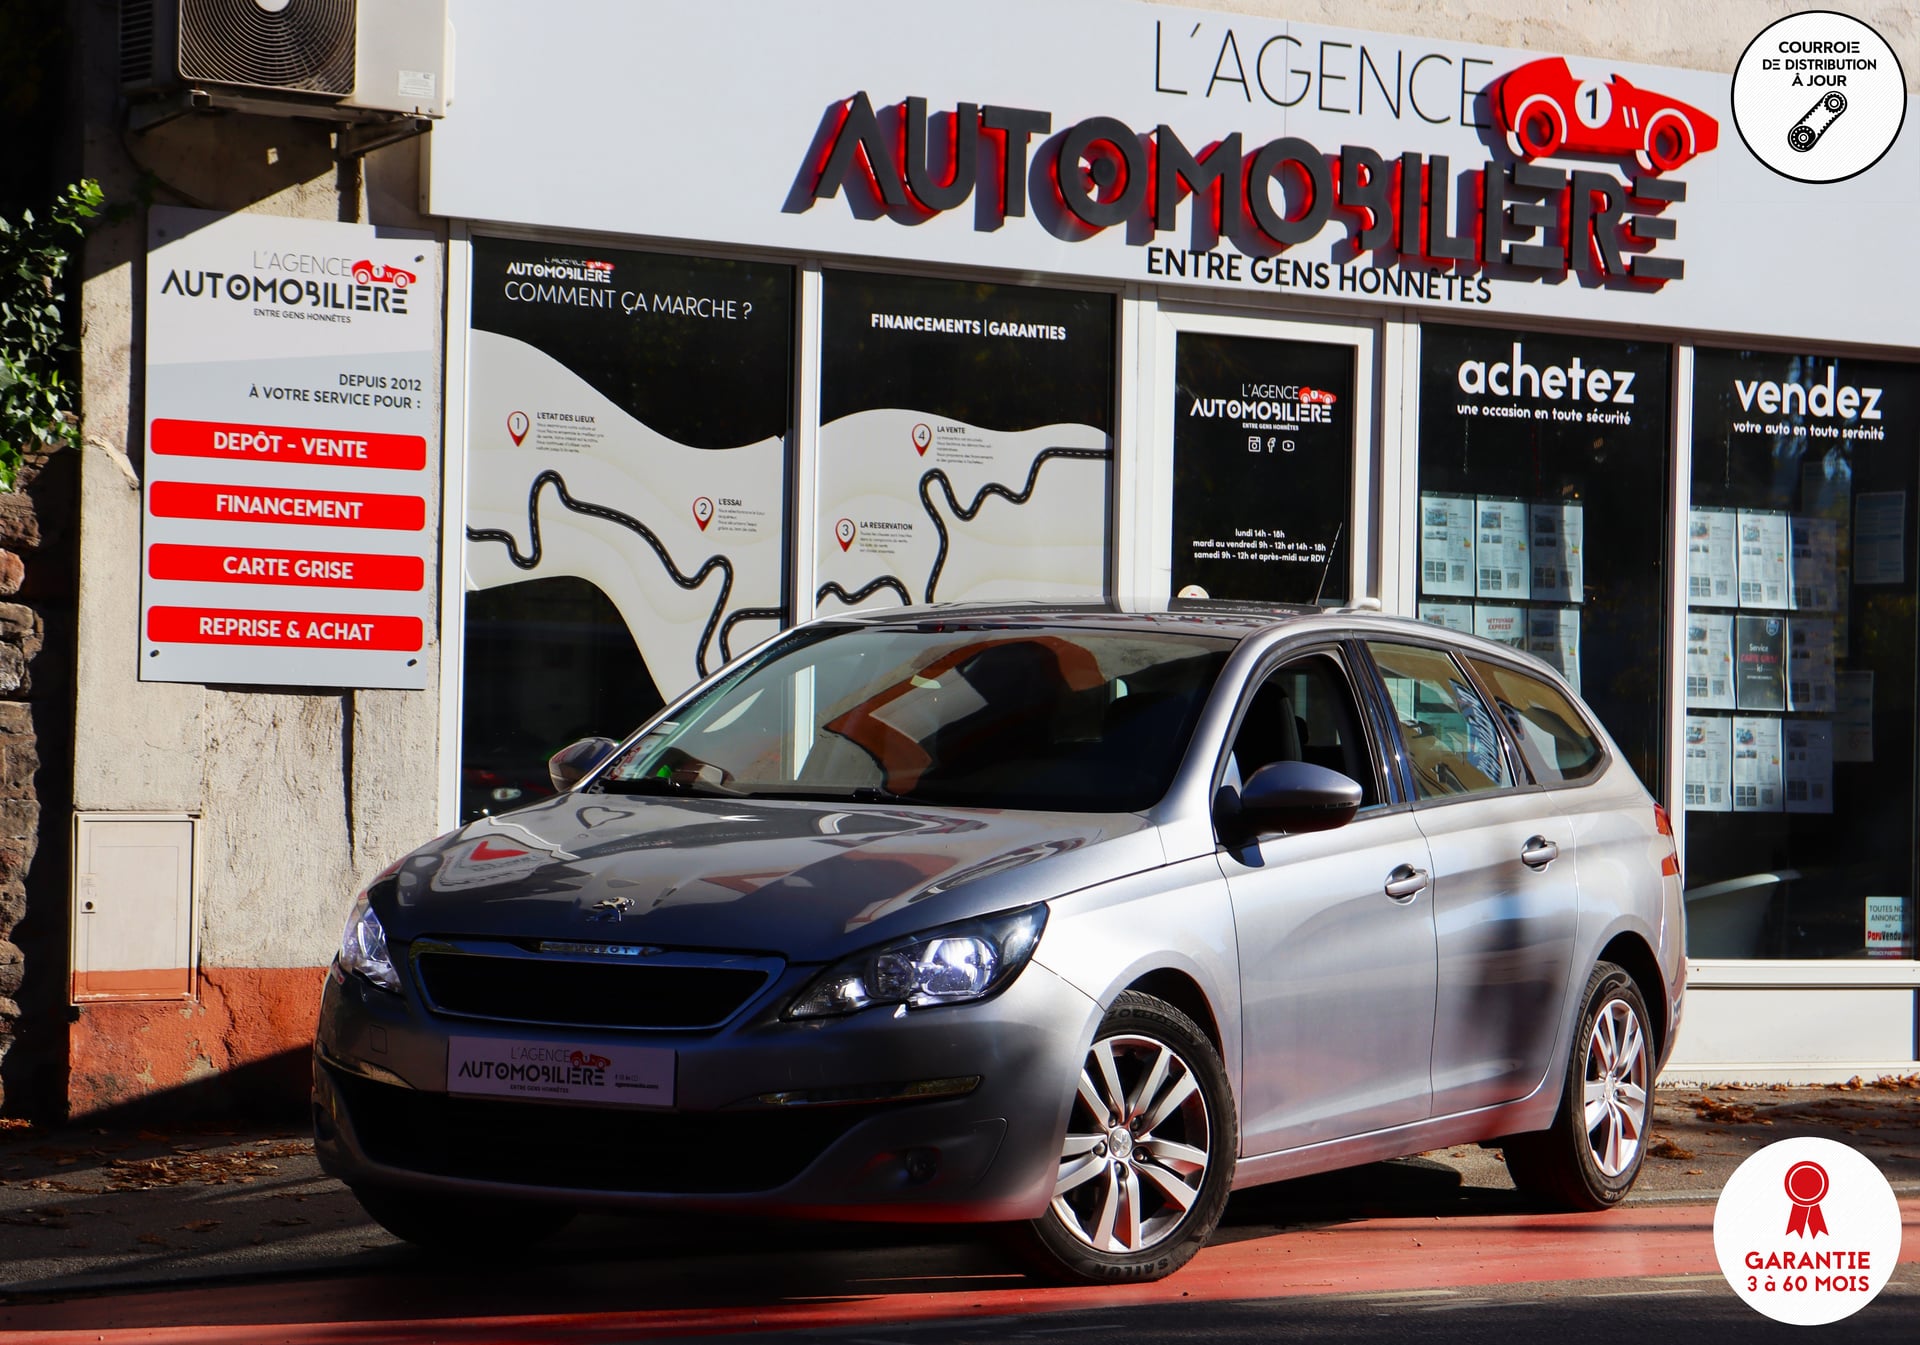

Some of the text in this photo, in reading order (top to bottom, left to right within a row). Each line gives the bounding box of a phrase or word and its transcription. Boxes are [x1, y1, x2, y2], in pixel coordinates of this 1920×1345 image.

[1155, 20, 1493, 129] L'AGENCE
[253, 250, 351, 277] L'AGENCE
[1148, 247, 1491, 303] ENTRE GENS HONNÊTES
[504, 281, 753, 320] COMMENT ÇA MARCHE ?
[254, 308, 351, 323] ENTRE GENS HONNÊTES
[871, 313, 1067, 341] FINANCEMENTS GARANTIES
[1457, 342, 1636, 404] achetez
[339, 374, 422, 391] DEPUIS 2012
[249, 384, 259, 397] À
[263, 387, 310, 402] VOTRE
[314, 390, 370, 406] SERVICE
[374, 394, 412, 409] POUR
[1241, 383, 1299, 400] L'AGENCE
[1734, 365, 1883, 420] vendez
[537, 412, 595, 423] L'ETAT DES LIEUX
[1457, 403, 1631, 425] une occasion en toute sécurité
[516, 417, 520, 430] 1
[1733, 420, 1762, 434] votre
[1765, 422, 1790, 436] auto
[1793, 426, 1807, 437] en
[1809, 424, 1839, 438] toute
[918, 430, 925, 441] 4
[213, 431, 283, 453] DEPÔT
[301, 437, 368, 459] VENTE
[216, 494, 363, 519] FINANCEMENT
[700, 502, 707, 515] 2
[718, 498, 742, 507] L'ESSAI
[842, 524, 849, 536] 3
[869, 522, 913, 530] RESERVATION
[1235, 528, 1253, 537] lundi
[1254, 529, 1266, 538] 14h
[1273, 530, 1285, 539] 18h
[1193, 539, 1214, 548] mardi
[1226, 540, 1257, 549] vendredi
[1258, 541, 1267, 549] 9h
[1274, 541, 1286, 550] 12h
[1296, 542, 1308, 551] 14h
[1314, 543, 1326, 552] 18h
[1194, 551, 1220, 559] samedi
[1221, 551, 1230, 560] 9h
[1238, 552, 1249, 560] 12h
[1259, 552, 1297, 563] après-midi
[1311, 554, 1325, 562] RDV
[223, 556, 353, 580] CARTE GRISE
[200, 617, 374, 641] REPRISE & ACHAT
[1870, 905, 1892, 913] TOUTES
[511, 1047, 571, 1063] L'AGENCE
